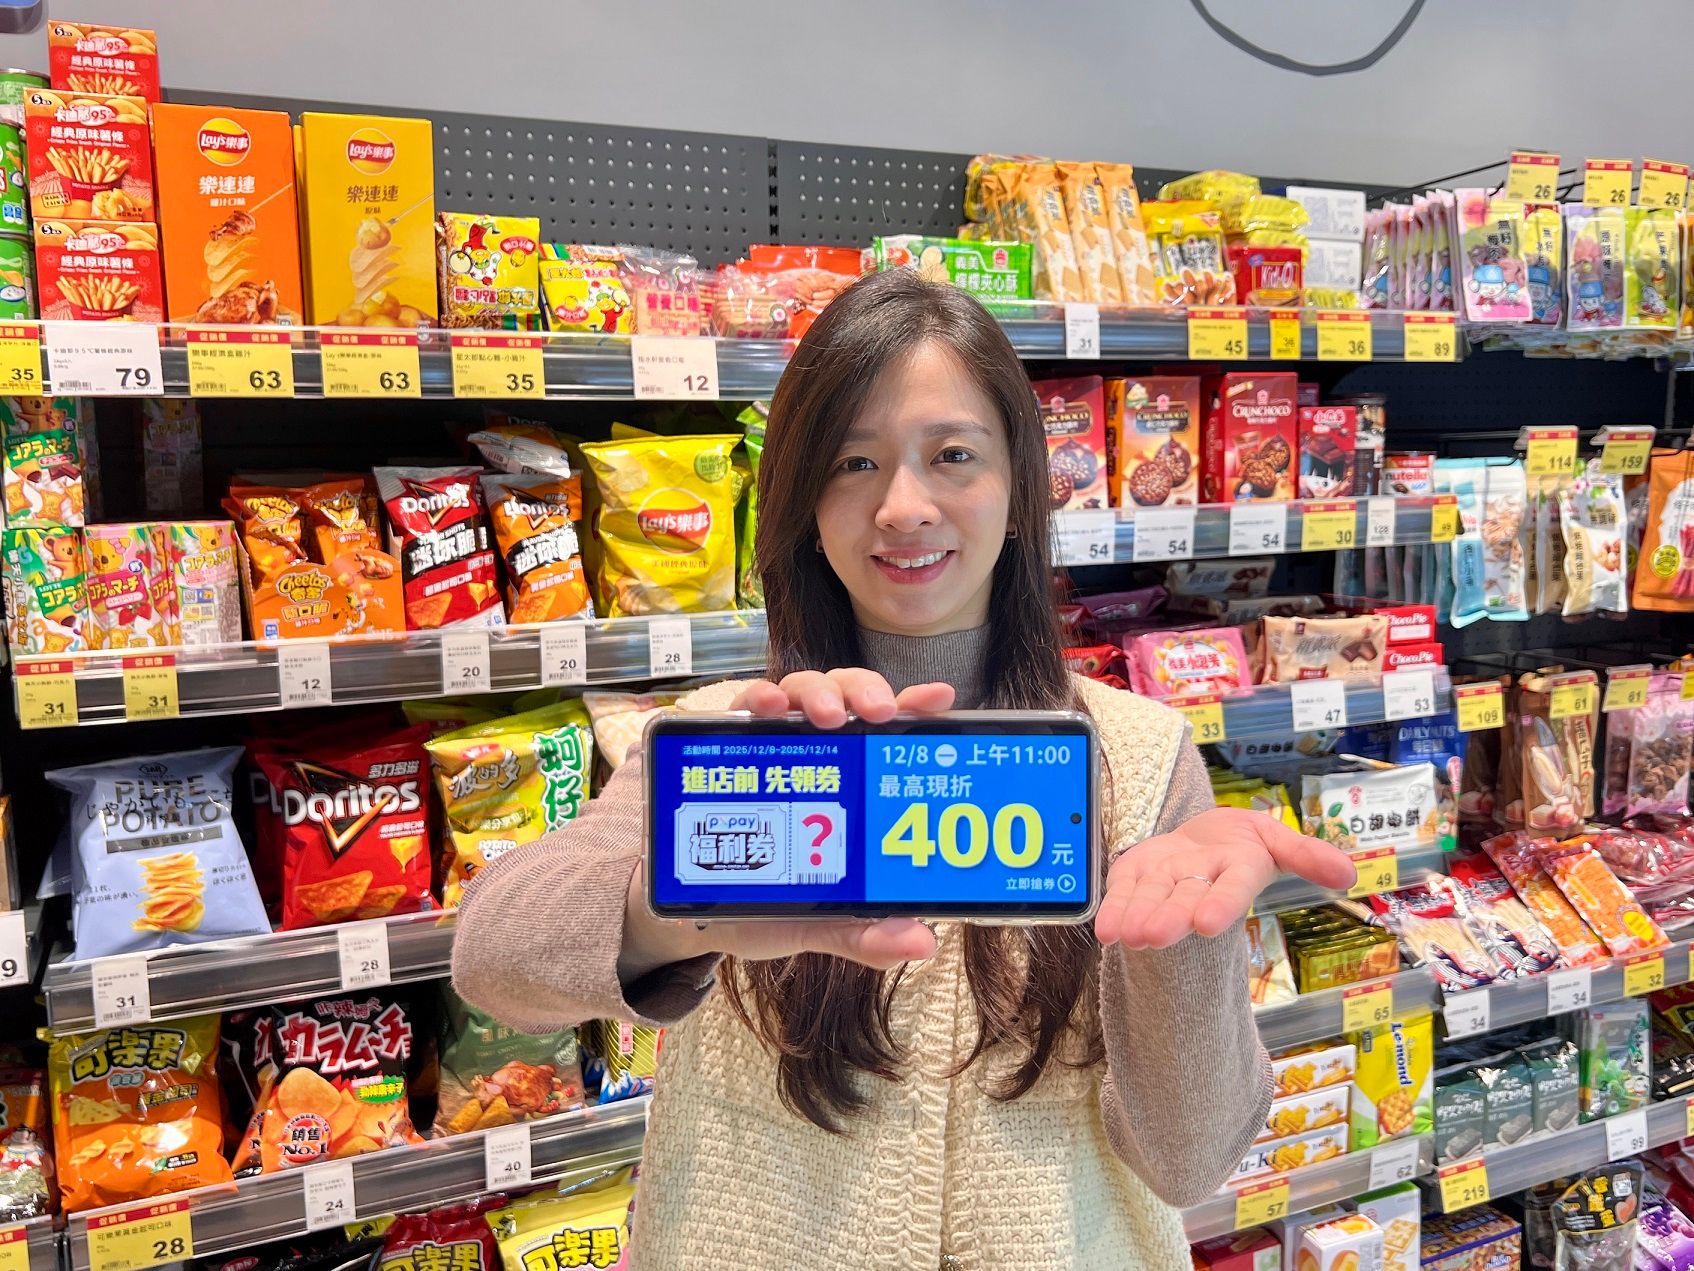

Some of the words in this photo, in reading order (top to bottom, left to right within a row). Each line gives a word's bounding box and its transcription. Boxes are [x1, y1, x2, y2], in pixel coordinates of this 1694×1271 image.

[71, 56, 136, 71] 經典原味薯條
[50, 126, 124, 143] 經典原味薯條
[199, 175, 256, 195] 樂連連
[1535, 184, 1551, 199] 26
[347, 184, 399, 204] 樂連連
[1610, 189, 1626, 203] 26
[1664, 192, 1680, 206] 26
[60, 255, 134, 269] 經典原味薯條
[199, 332, 228, 342] 促銷價
[252, 333, 279, 343] 促銷價
[332, 334, 358, 344] 促銷價
[381, 335, 406, 345] 促銷價
[462, 337, 487, 346] 促銷價
[508, 338, 532, 348] 促銷價
[1079, 338, 1092, 349] 31
[1224, 340, 1243, 355] 45
[1348, 340, 1365, 355] 36
[1434, 342, 1450, 355] 89
[11, 368, 34, 381] 35
[116, 368, 151, 388] 79
[249, 371, 282, 389] 63
[379, 372, 410, 390] 63
[506, 373, 535, 391] 35
[683, 375, 709, 391] 12
[1232, 404, 1292, 418] CRUNCHOCO
[12, 437, 71, 461] コアラのマーチ
[1548, 456, 1572, 469] 114
[1620, 455, 1643, 469] 159
[1385, 469, 1430, 482] nutella
[401, 494, 470, 514] Doritos
[503, 497, 569, 517] Doritos
[1262, 533, 1280, 547] 54
[1336, 530, 1353, 544] 30
[1089, 543, 1110, 557] 54
[1168, 539, 1188, 554] 54
[89, 575, 140, 600] コアラのマーチ
[278, 573, 329, 592] Cheetos
[290, 587, 323, 602] 奇多
[134, 658, 163, 667] 促銷價
[560, 659, 577, 669] 20
[665, 653, 681, 663] 28
[30, 663, 60, 673] 促銷價
[462, 666, 481, 677] 20
[301, 679, 321, 690] 12
[148, 695, 168, 707] 31
[1414, 697, 1430, 713] 53
[44, 703, 65, 715] 31
[1325, 709, 1341, 724] 47
[1477, 710, 1499, 724] 109
[1202, 722, 1221, 738] 33
[683, 745, 720, 756] 活動時間
[723, 745, 838, 756] 2025/12/8-2025/12/14
[881, 744, 928, 767] 12/8
[966, 744, 1071, 766] 上午11:00
[369, 760, 419, 779] 多力多滋
[534, 722, 584, 832] 蚵仔
[682, 766, 759, 794] 進店前
[765, 766, 841, 794] 先領券
[879, 774, 973, 798] 最高現折
[115, 775, 205, 804] PURE
[283, 781, 421, 826] Doritos
[104, 800, 222, 832] POTATO
[881, 802, 1044, 868] 400
[1051, 843, 1074, 866] 元
[690, 833, 775, 865] 福利券
[1006, 877, 1055, 891] 立即搶券
[1376, 872, 1393, 887] 49
[1, 959, 18, 977] 9
[361, 962, 379, 973] 28
[1648, 973, 1662, 987] 32
[116, 994, 136, 1008] 31
[1573, 991, 1588, 1005] 34
[1374, 1007, 1390, 1021] 65
[1470, 1014, 1486, 1030] 34
[73, 1028, 186, 1083] 可樂果
[1391, 1023, 1413, 1087] Lemond
[292, 1127, 322, 1142] 銷售
[1632, 1136, 1645, 1150] 99
[505, 1161, 521, 1172] 40
[1463, 1184, 1486, 1201] 219
[325, 1199, 344, 1213] 24
[1267, 1202, 1284, 1217] 57
[99, 1213, 127, 1226] 促銷價
[150, 1203, 178, 1216] 促銷價
[153, 1238, 185, 1259] 28
